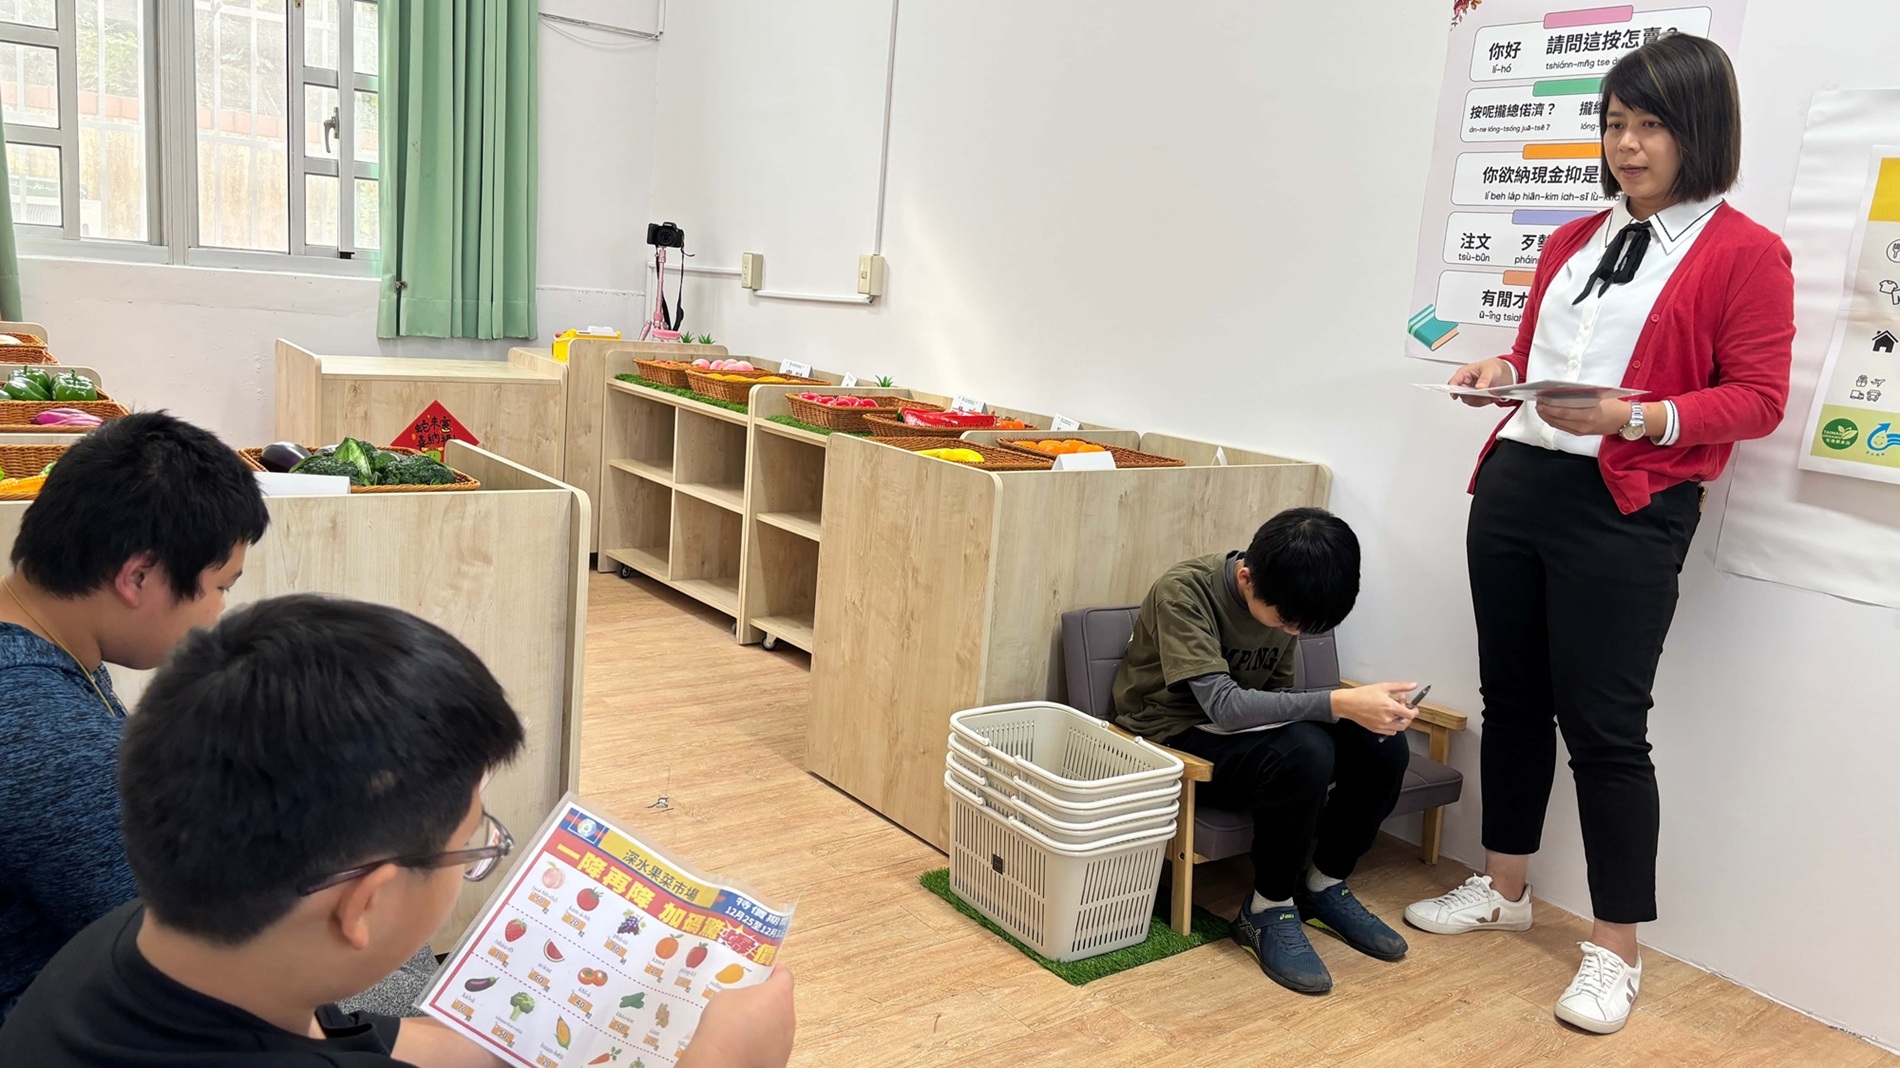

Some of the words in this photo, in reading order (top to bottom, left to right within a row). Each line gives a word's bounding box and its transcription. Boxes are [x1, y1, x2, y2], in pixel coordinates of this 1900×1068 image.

[1488, 41, 1522, 61] 你好
[1545, 27, 1678, 56] 請問這按怎賣
[1482, 165, 1602, 184] 你欲納現金抑是
[1491, 191, 1506, 200] beh
[1460, 232, 1491, 250] 注文
[1514, 254, 1539, 265] pháin
[556, 843, 657, 910] 一降再降
[622, 849, 700, 903] 深水果菜市場
[569, 917, 580, 928] 20
[534, 974, 545, 984] 60
[575, 999, 586, 1009] 40
[499, 1029, 508, 1040] 50
